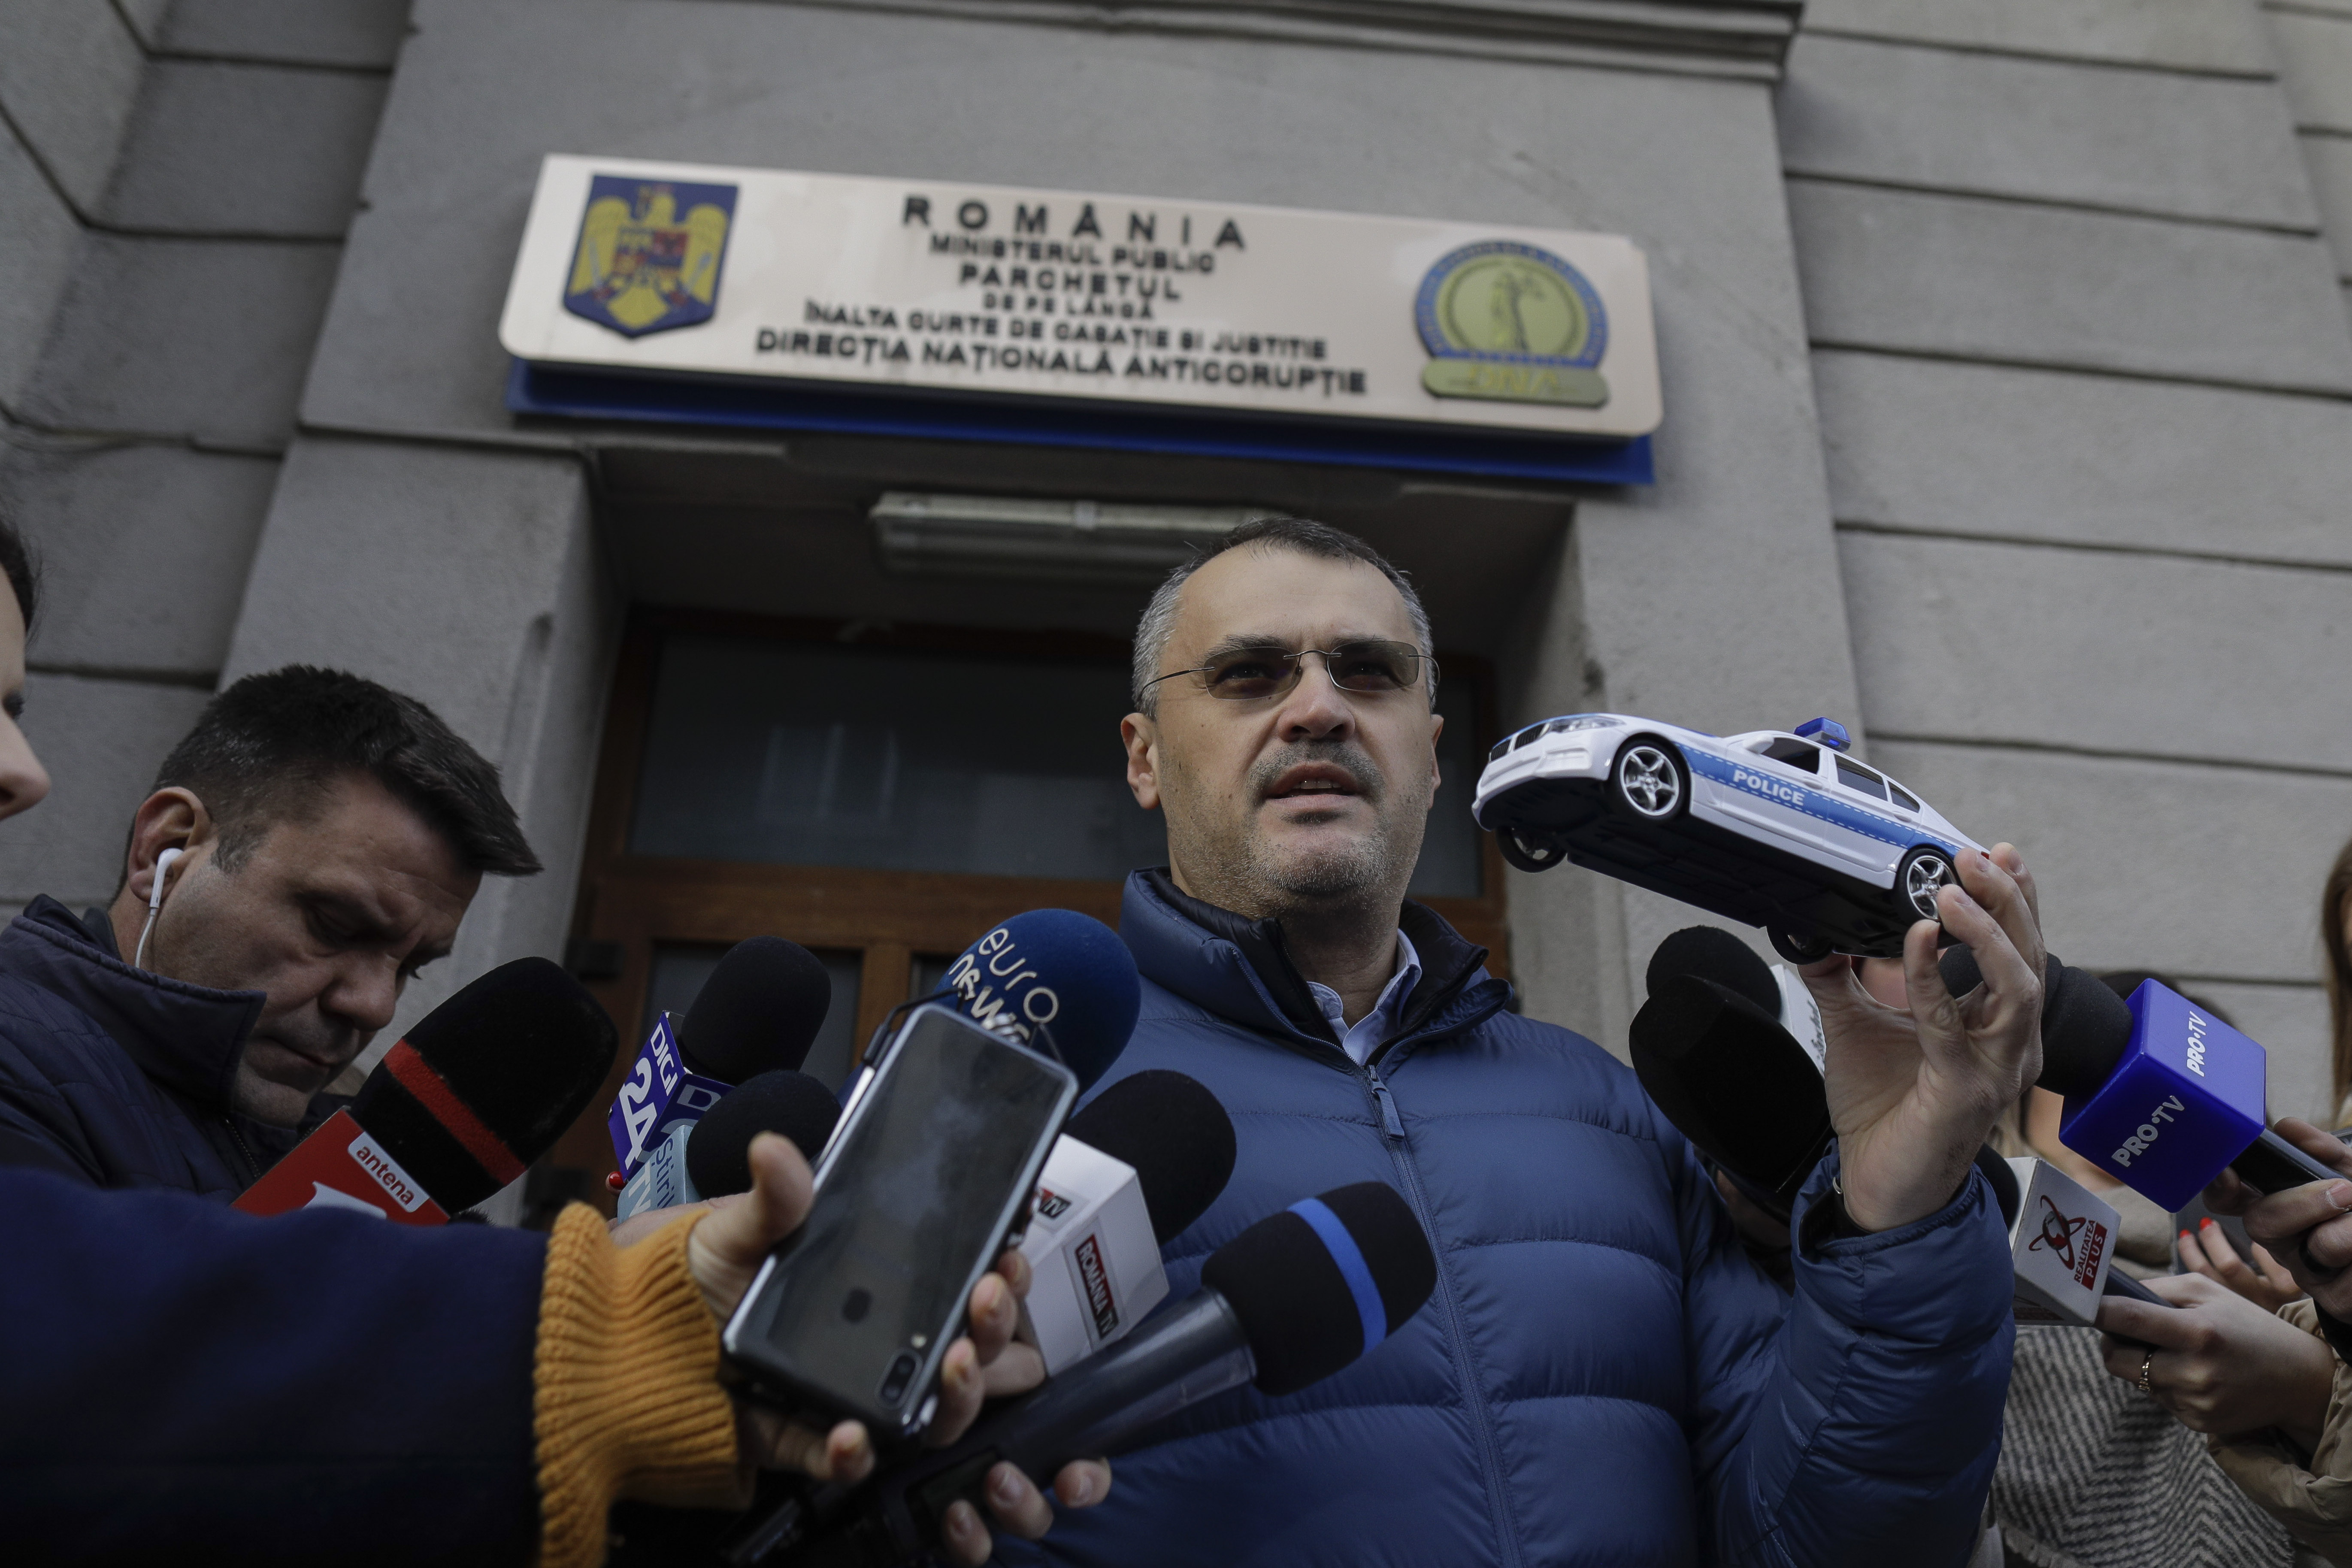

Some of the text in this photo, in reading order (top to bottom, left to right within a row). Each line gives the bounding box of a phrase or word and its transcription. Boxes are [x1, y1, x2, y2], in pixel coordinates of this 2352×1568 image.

[902, 196, 1244, 251] ROMÂNIA
[929, 233, 1214, 274] MINISTERUL PUBLIC
[960, 261, 1181, 302] PARCHETUL
[908, 309, 998, 338] CURTE
[1009, 318, 1043, 340] DE
[984, 293, 1014, 311] DE
[1027, 295, 1054, 314] PE
[1733, 769, 1805, 806] POLICE
[978, 928, 1059, 1024] euro
[650, 1022, 678, 1096] DIGI
[619, 1057, 657, 1170] 24
[356, 1146, 415, 1205] antena
[651, 1138, 675, 1208] Știril
[2074, 1220, 2096, 1283] REALITATEA
[2086, 1234, 2103, 1278] PLUS
[1078, 1241, 1114, 1334] ROMÂNIA TV
